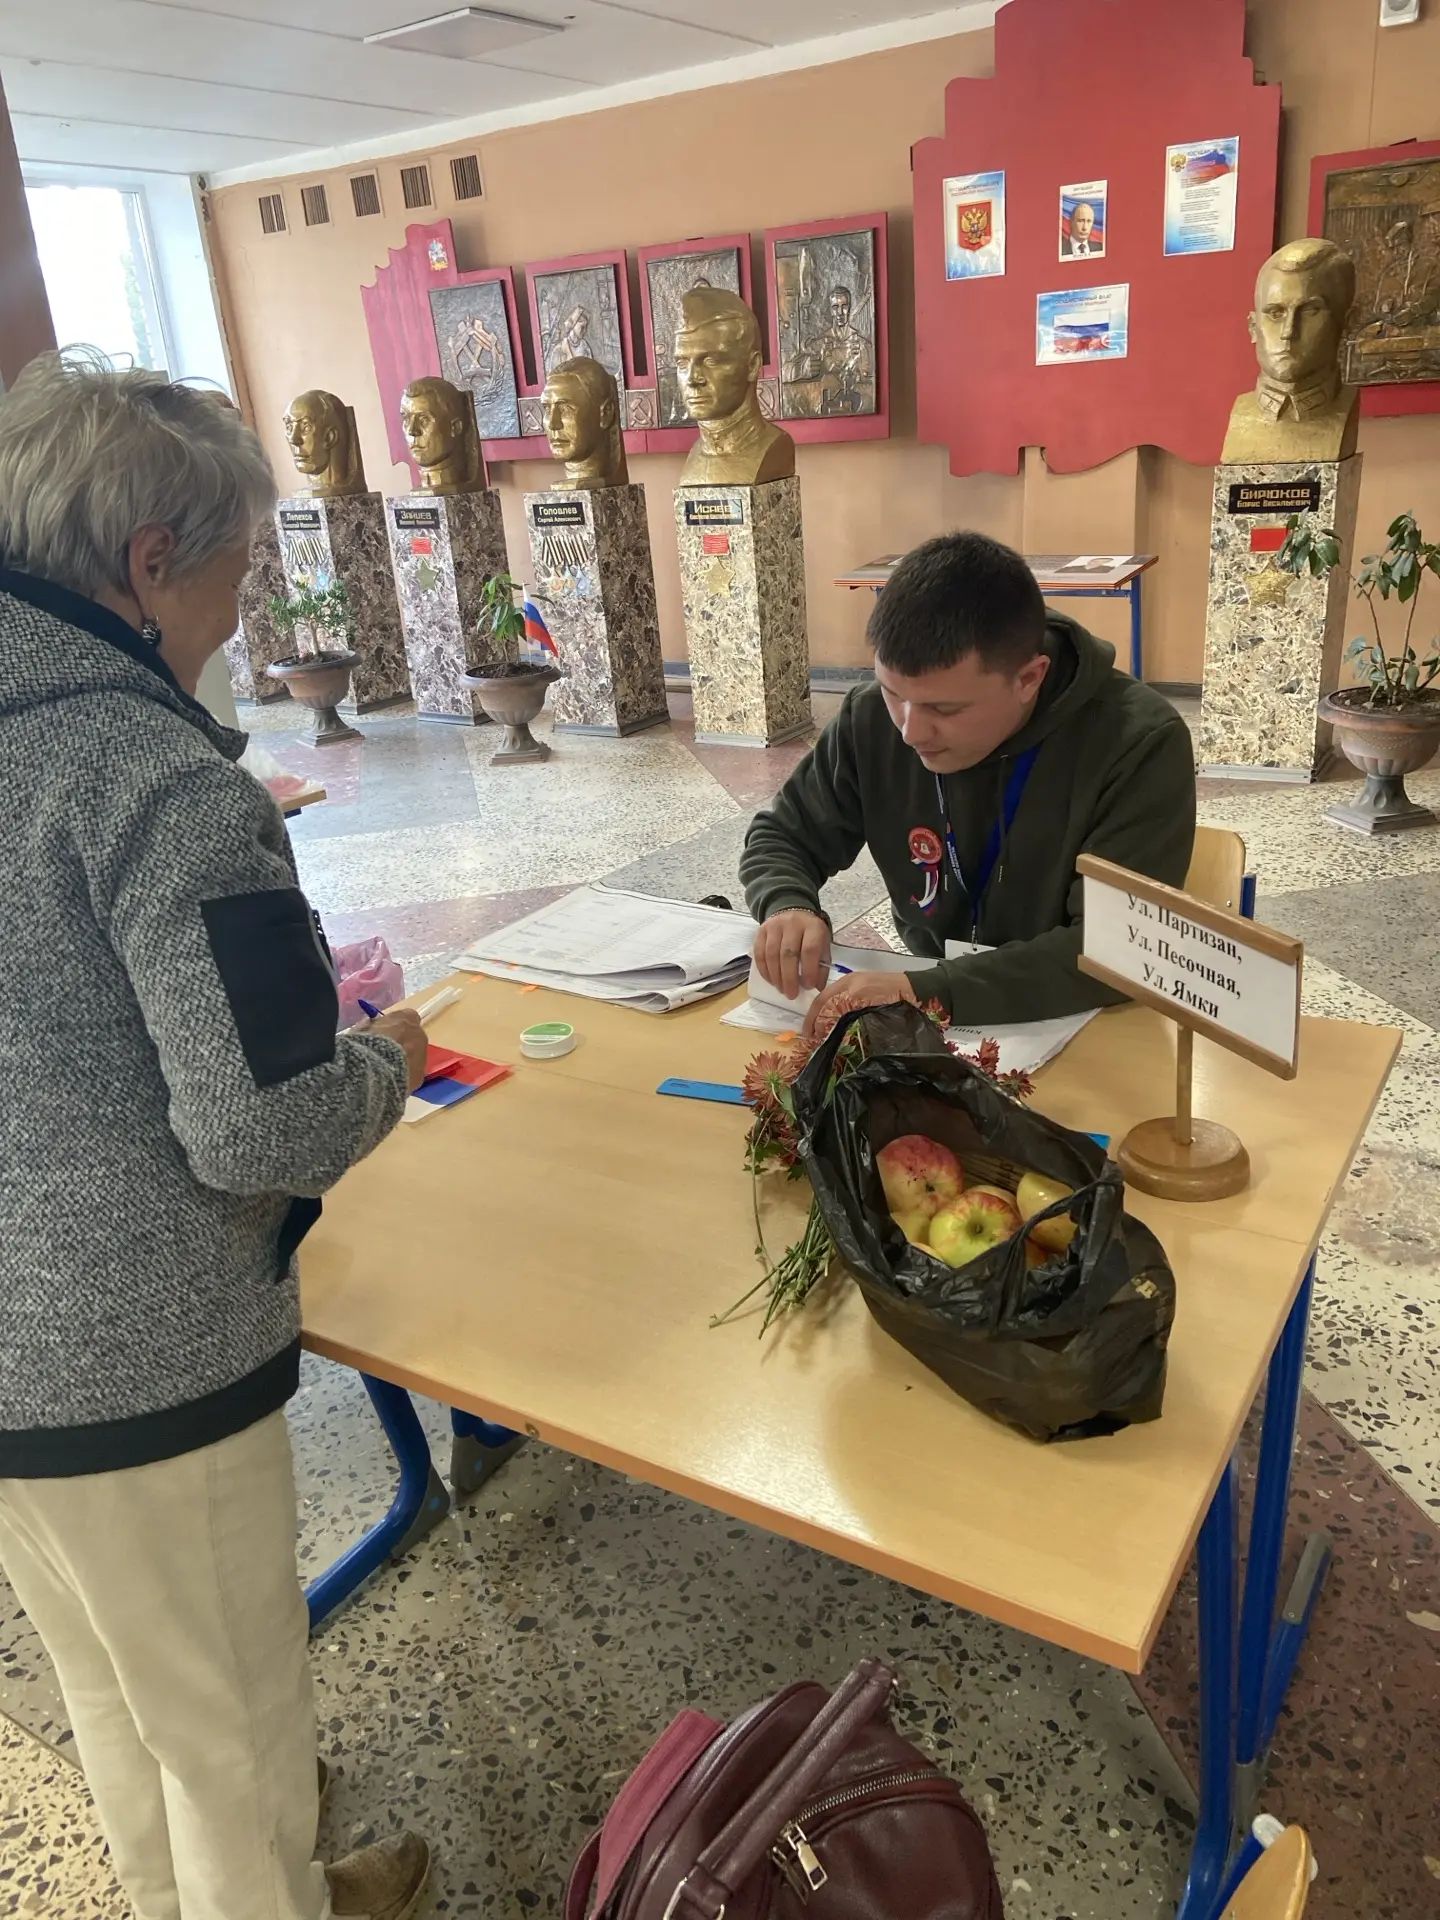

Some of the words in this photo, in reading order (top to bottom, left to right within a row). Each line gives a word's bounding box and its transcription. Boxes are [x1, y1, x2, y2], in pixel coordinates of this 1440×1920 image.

[1127, 924, 1152, 952] Ул.
[1158, 939, 1241, 999] Песочная,
[1158, 906, 1242, 964] Партизан,
[1142, 963, 1168, 992] Ул.
[1172, 980, 1219, 1019] Ямки
